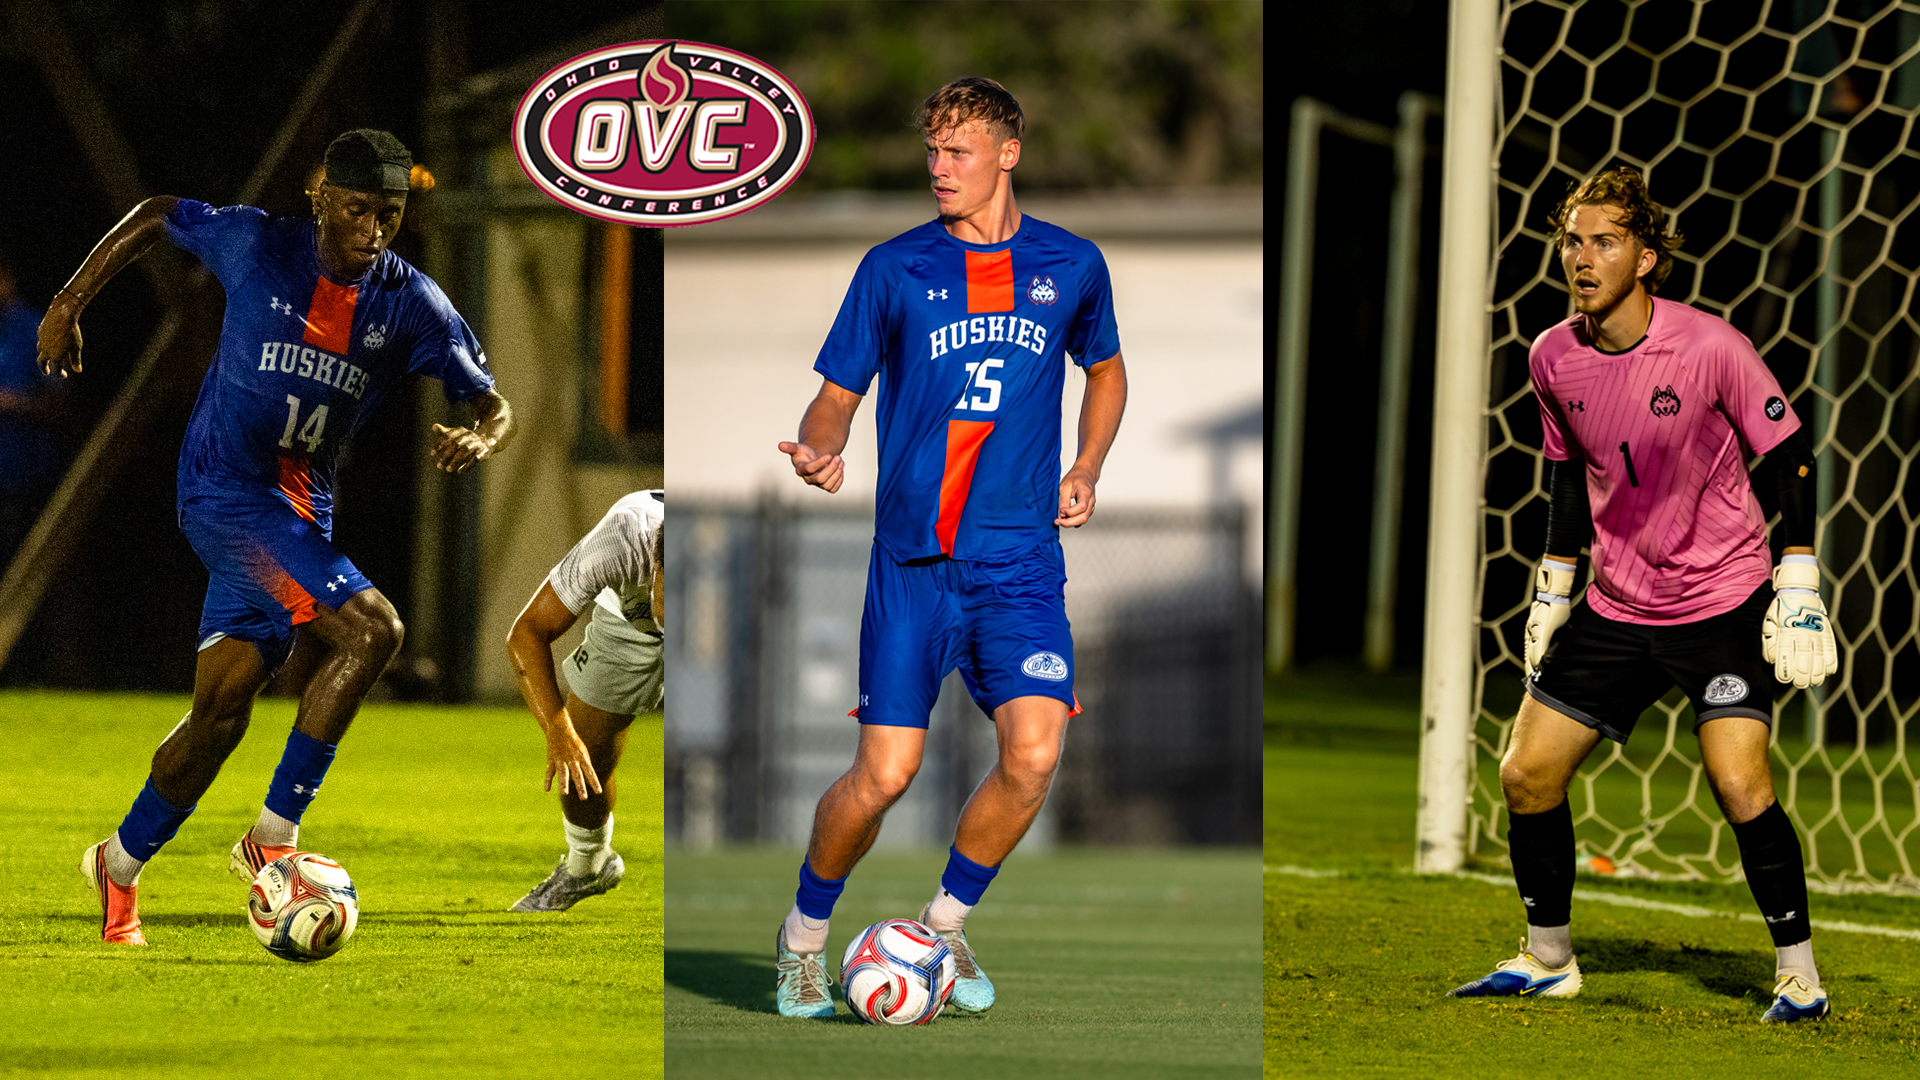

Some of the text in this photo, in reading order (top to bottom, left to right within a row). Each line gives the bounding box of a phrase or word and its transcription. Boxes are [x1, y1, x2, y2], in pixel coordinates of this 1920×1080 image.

[929, 316, 1047, 361] HUSKIES
[258, 342, 370, 400] HUSKIES
[955, 358, 1005, 412] 15
[278, 393, 329, 453] 14
[1619, 441, 1640, 488] 1
[1032, 660, 1061, 673] OVC
[1709, 683, 1737, 698] OVC
